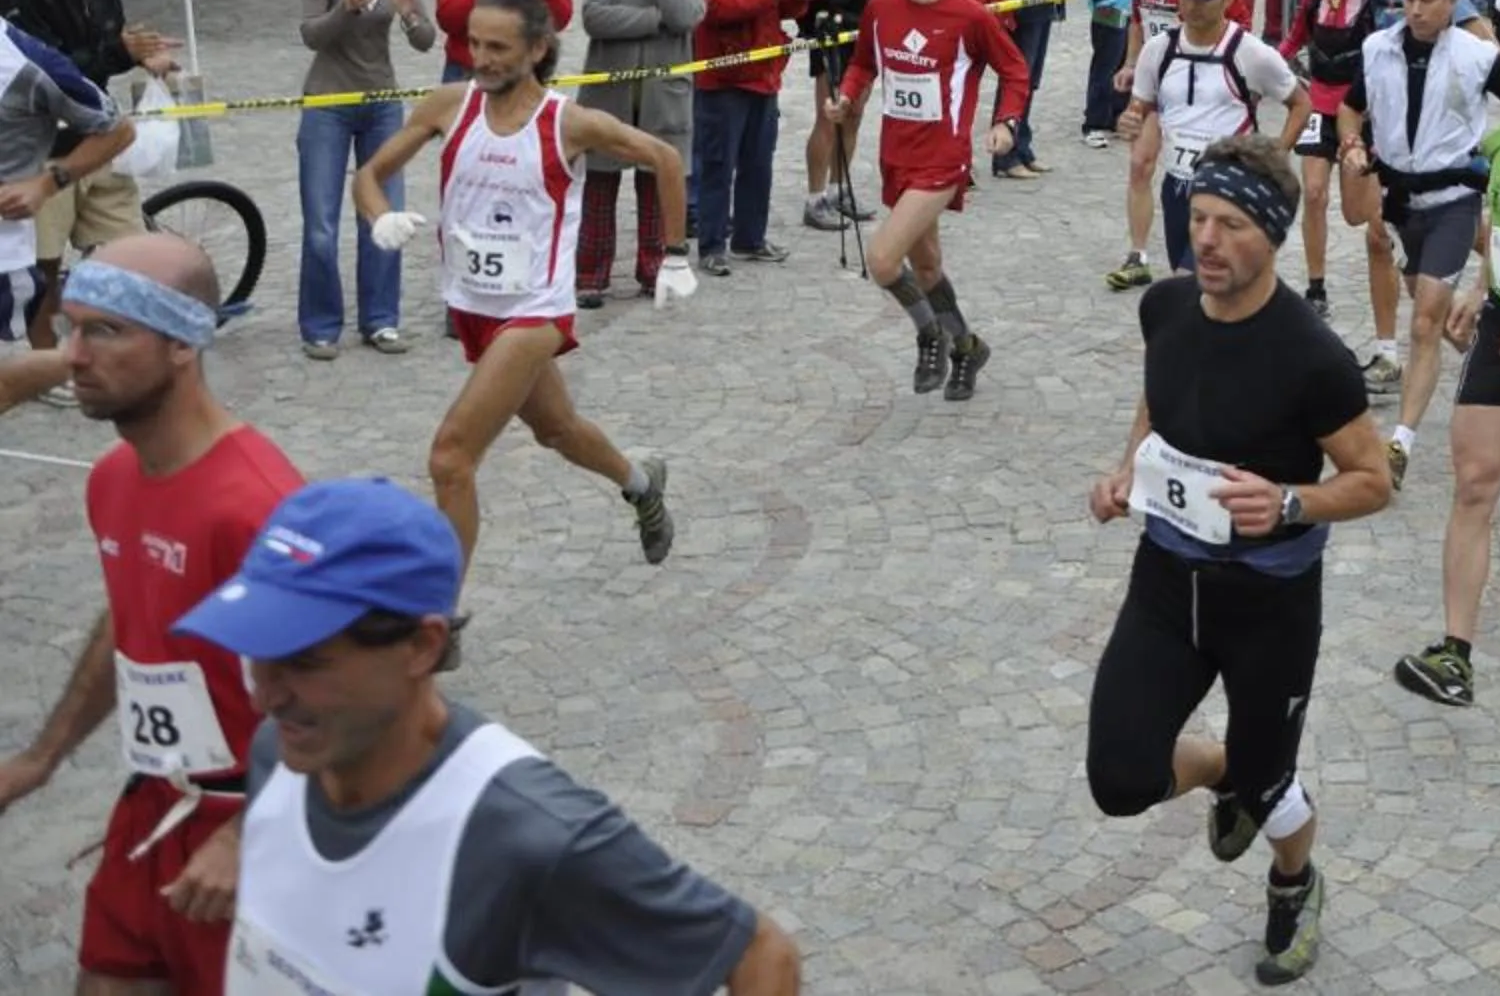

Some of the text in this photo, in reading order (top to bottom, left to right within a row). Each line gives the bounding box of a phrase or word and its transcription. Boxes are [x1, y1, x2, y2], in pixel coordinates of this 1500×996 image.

[894, 89, 923, 110] 50
[1174, 146, 1201, 172] 77
[466, 249, 505, 278] 35
[1166, 477, 1187, 510] 8
[129, 700, 181, 747] 28
